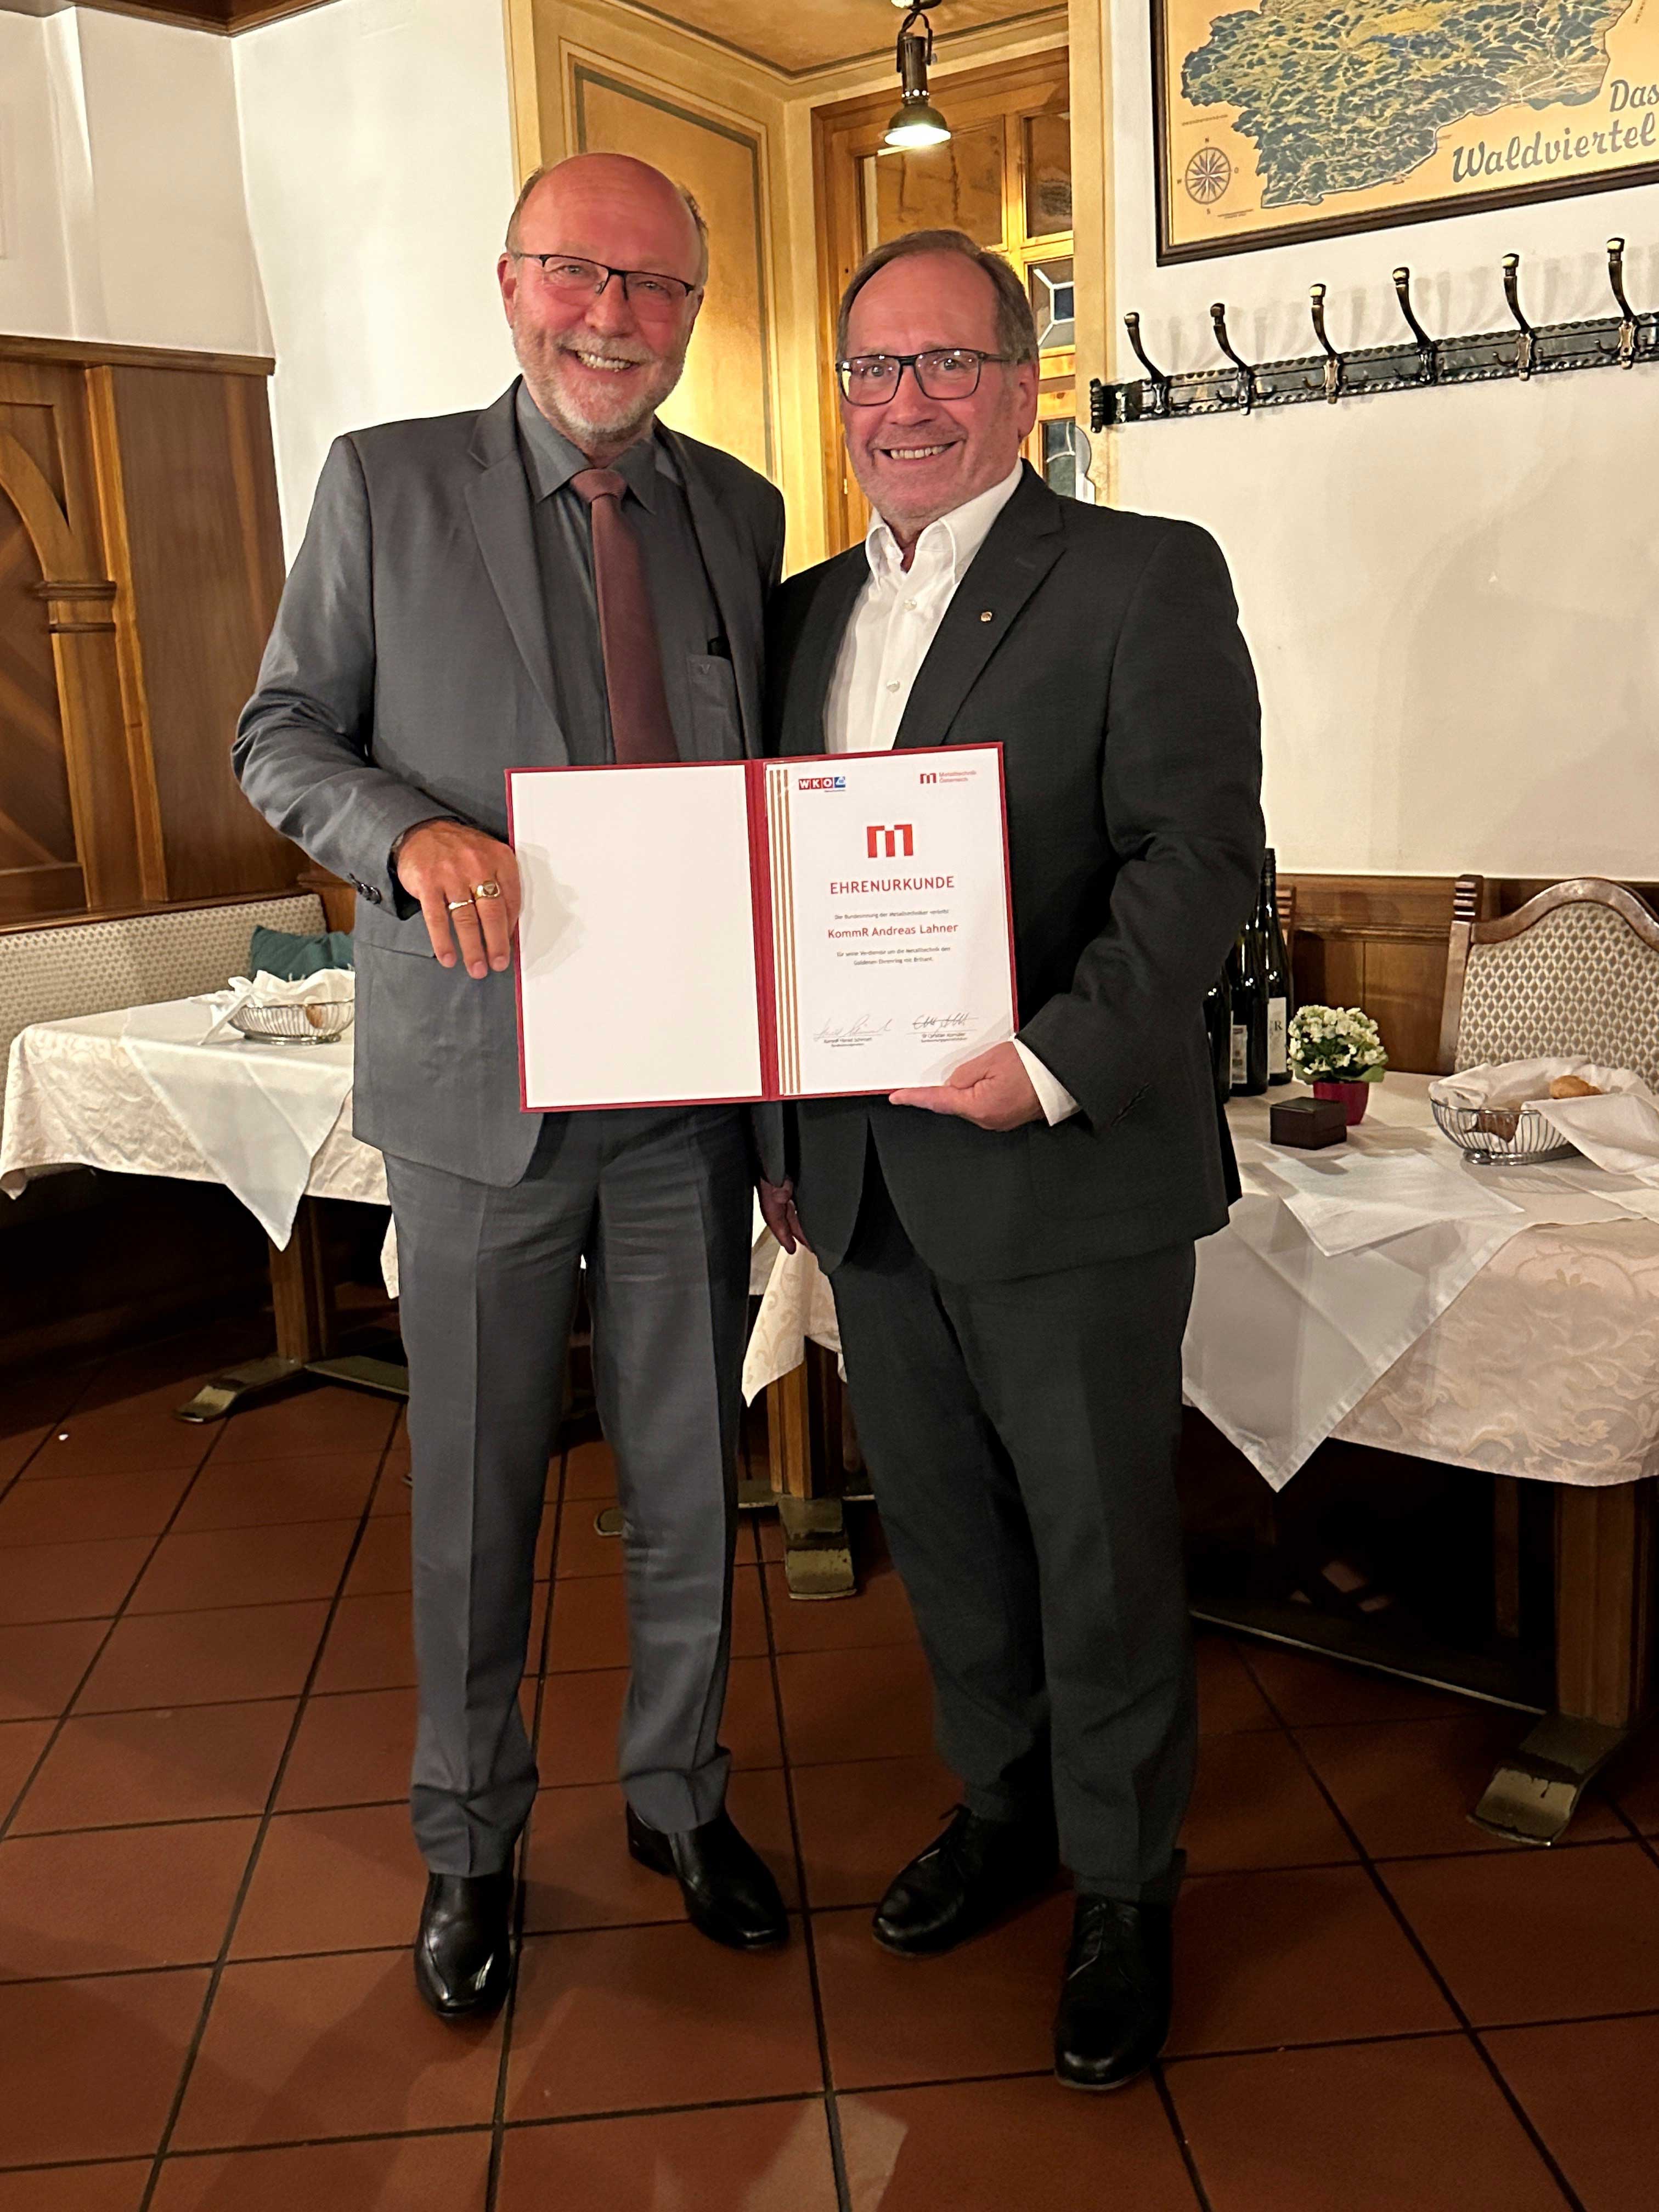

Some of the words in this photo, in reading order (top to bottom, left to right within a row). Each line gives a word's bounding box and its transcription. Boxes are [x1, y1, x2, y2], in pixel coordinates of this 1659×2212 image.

[1610, 79, 1659, 112] Das
[1452, 111, 1656, 183] Waldviertel
[799, 778, 833, 789] WKO
[830, 876, 955, 894] EHRENURKUNDE
[828, 928, 869, 939] KommR
[872, 926, 916, 936] Andreas
[920, 924, 959, 934] Lahner
